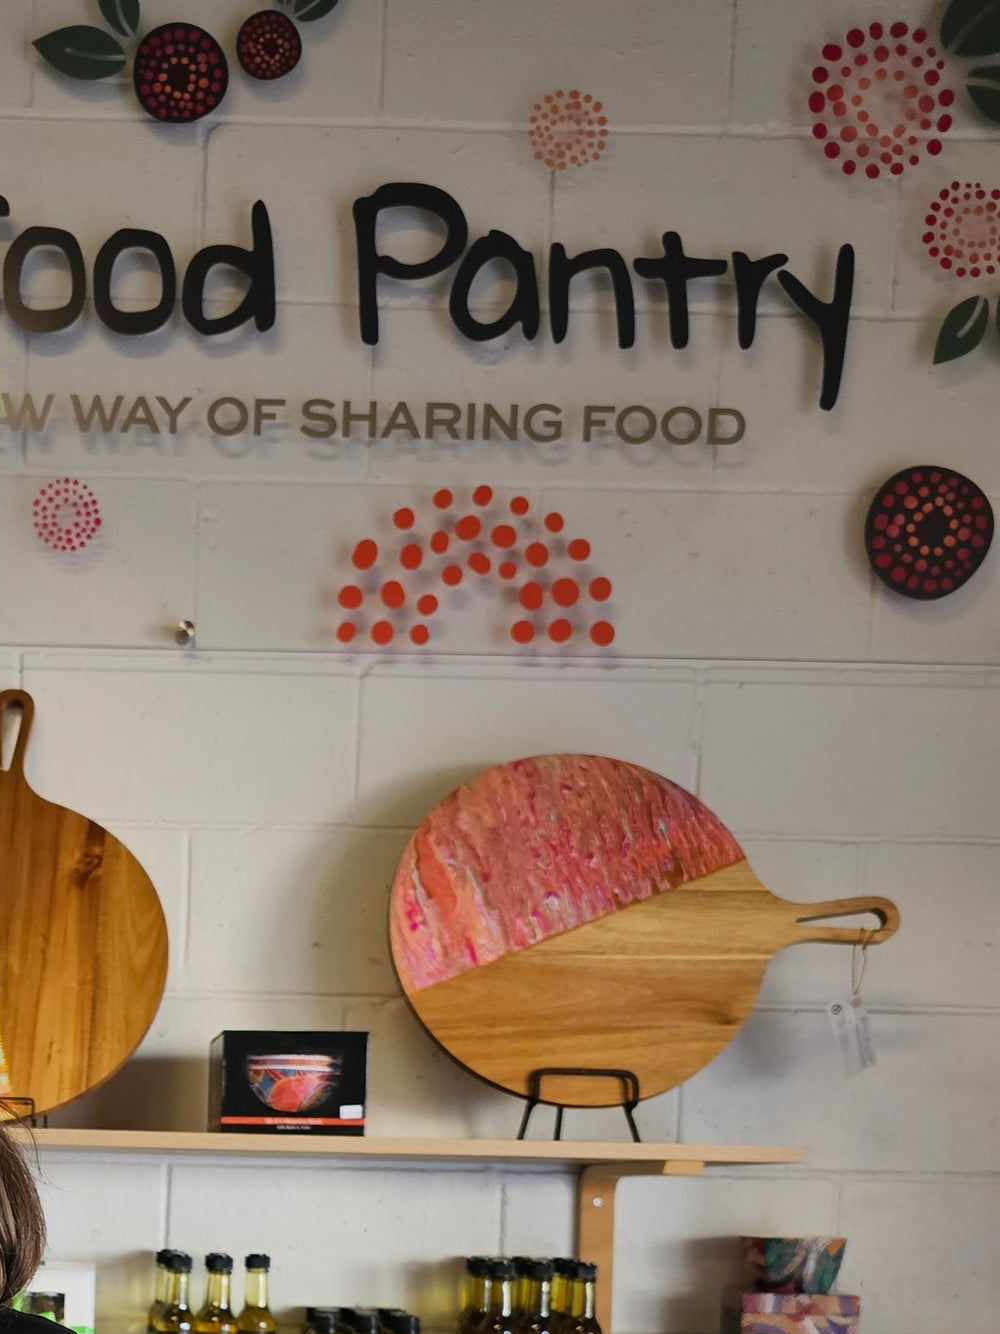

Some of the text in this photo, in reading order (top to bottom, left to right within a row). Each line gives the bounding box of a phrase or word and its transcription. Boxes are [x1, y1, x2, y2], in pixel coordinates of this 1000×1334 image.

[351, 181, 856, 411] Pantry
[69, 394, 193, 436] WAY
[206, 396, 287, 437] OF
[299, 398, 564, 444] SHARING
[581, 404, 746, 447] FOOD
